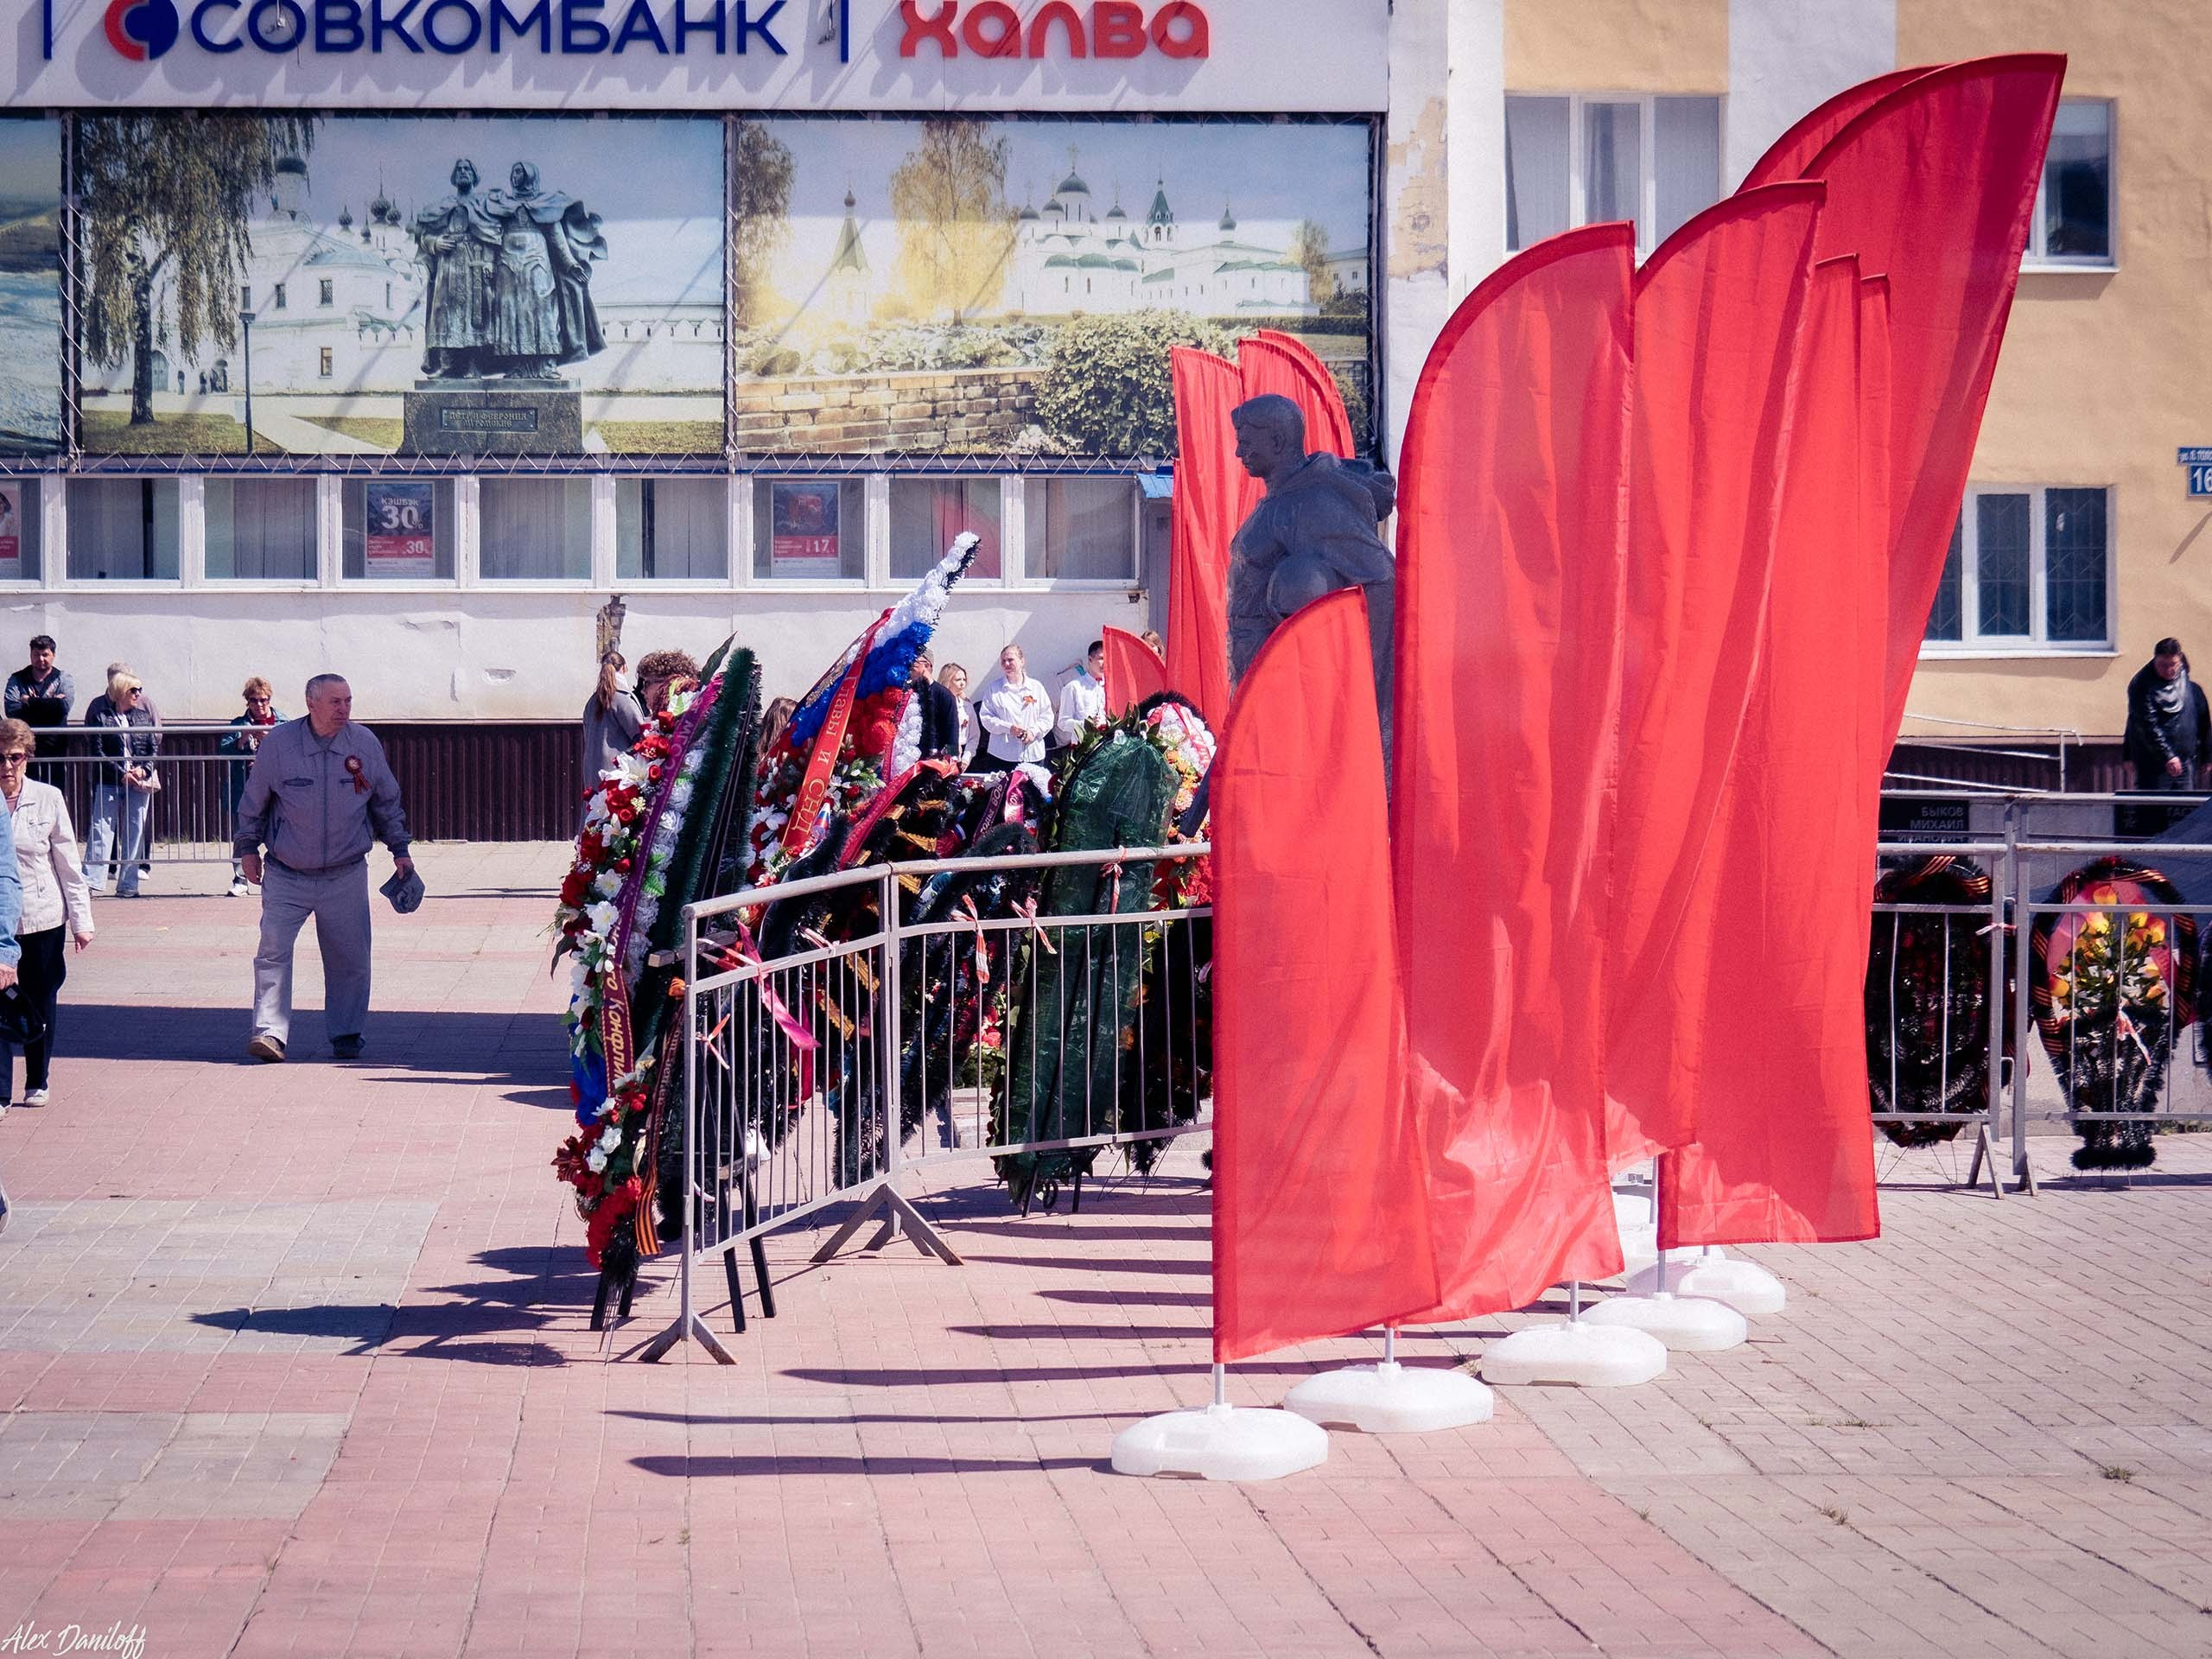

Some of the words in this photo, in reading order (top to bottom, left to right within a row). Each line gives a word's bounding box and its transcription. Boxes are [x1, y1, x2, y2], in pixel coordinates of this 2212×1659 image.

[190, 0, 787, 54] СОВКОМБАНК
[381, 497, 419, 506] КЭШБЭК
[830, 676, 858, 737] Главы
[791, 778, 825, 835] СНД
[1910, 819, 1964, 830] МИХАИЛ
[1921, 805, 1964, 817] БЫКОВ
[607, 996, 626, 1083] Конфли
